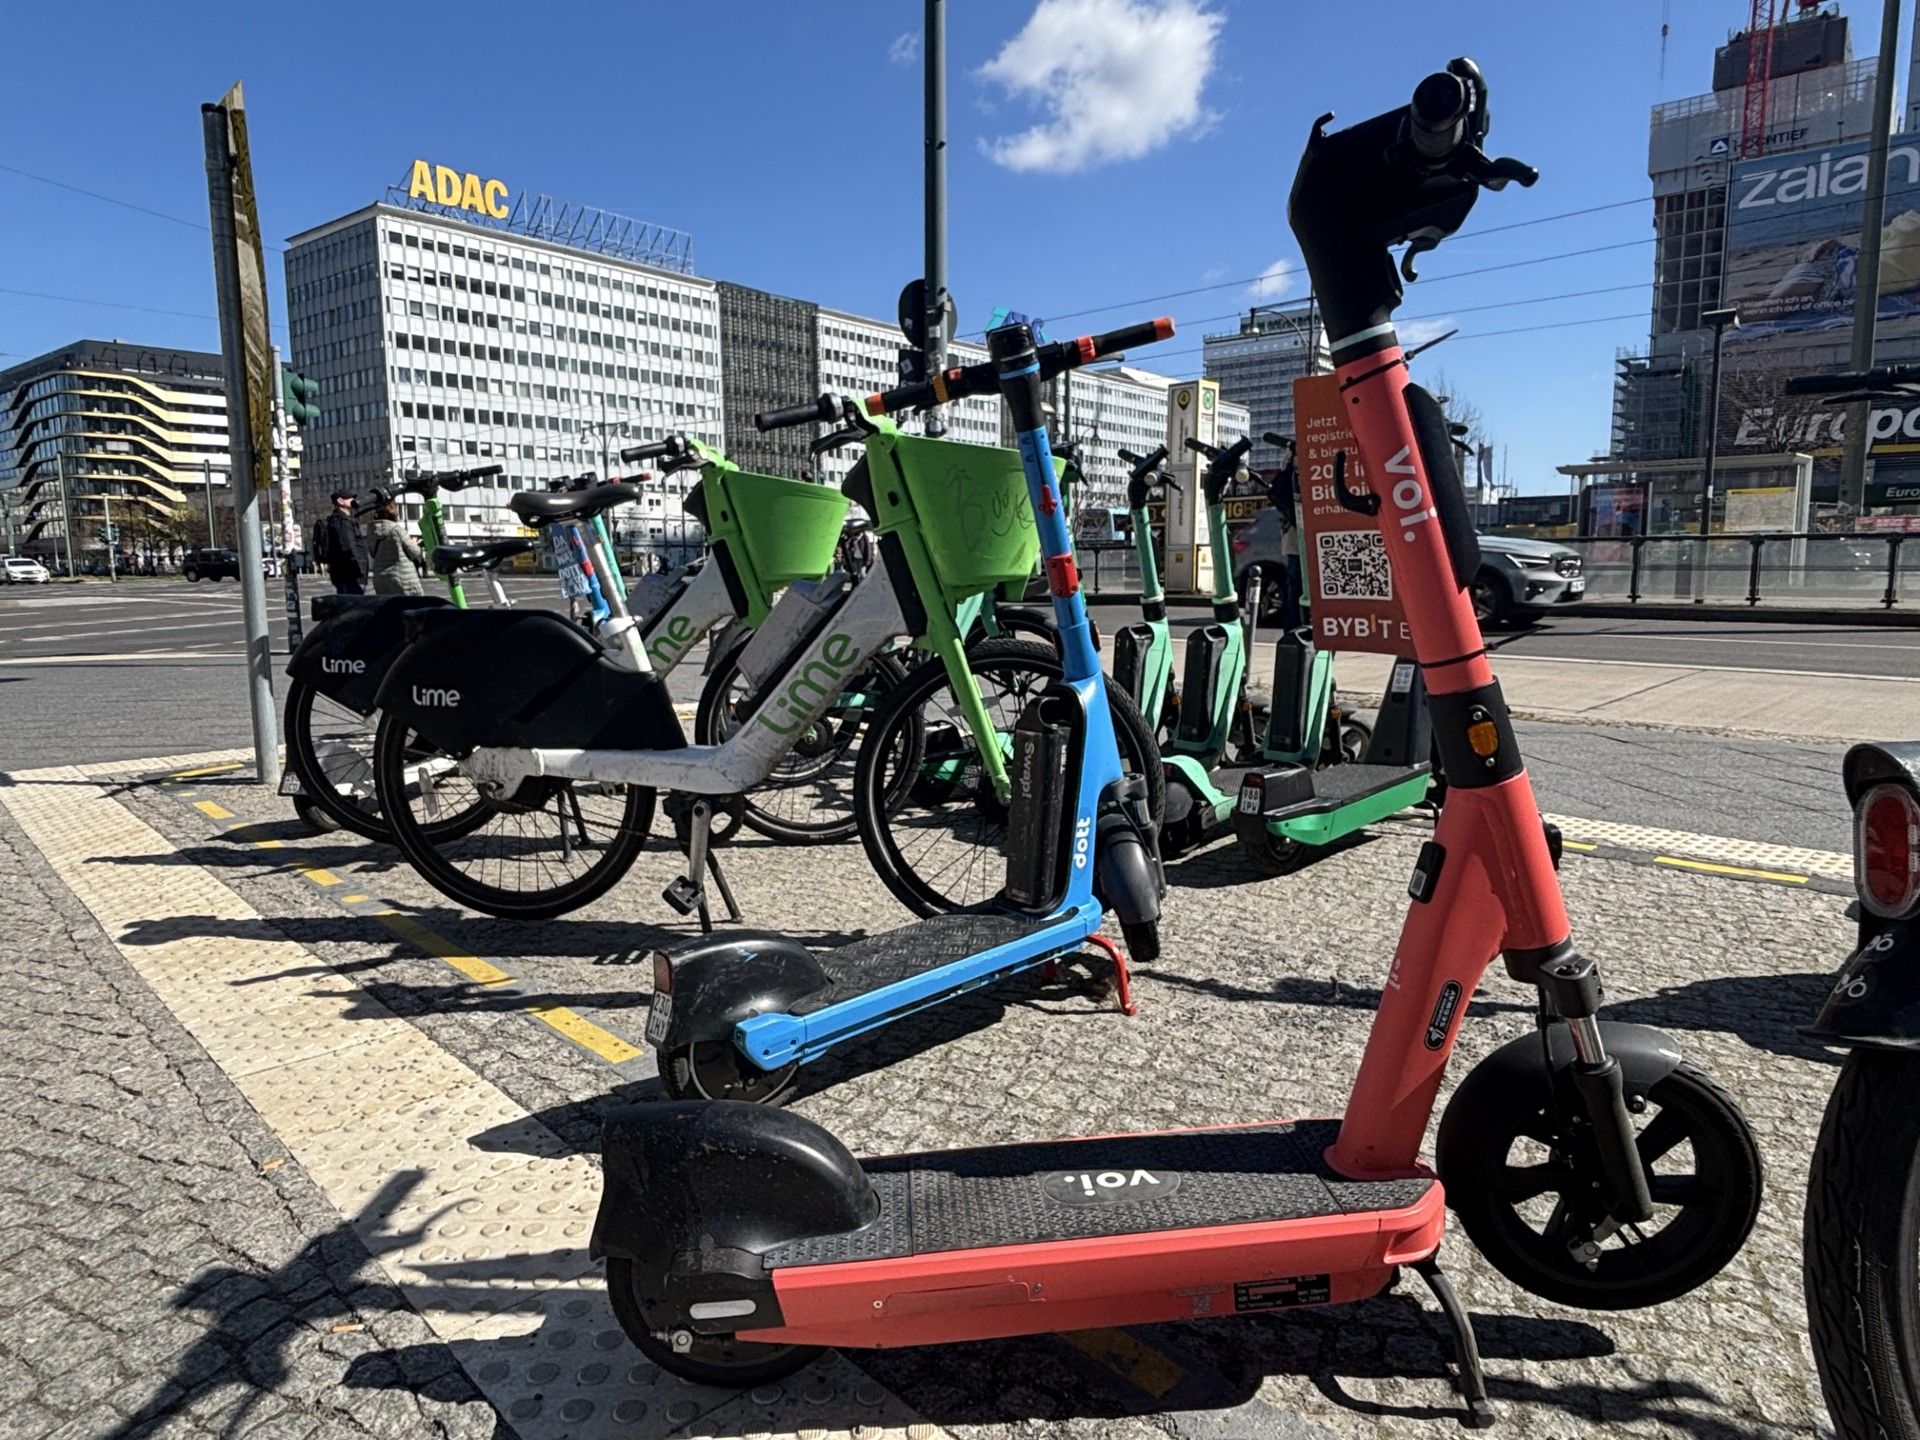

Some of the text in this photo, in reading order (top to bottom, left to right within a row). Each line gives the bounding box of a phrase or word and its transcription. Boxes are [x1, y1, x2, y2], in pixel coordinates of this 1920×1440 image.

[409, 159, 509, 219] ADAC
[1306, 416, 1337, 429] Jetzt
[1308, 448, 1318, 459] &
[1320, 446, 1339, 458] bis
[1311, 481, 1371, 501] Bitoi
[1383, 444, 1438, 543] voi.
[1322, 613, 1392, 639] BYBIT
[321, 656, 366, 674] Lime
[412, 685, 461, 707] Lime
[755, 633, 861, 735] Lime
[1018, 741, 1036, 799] Swap!
[1073, 816, 1091, 870] dott
[1063, 1169, 1161, 1197] voi.
